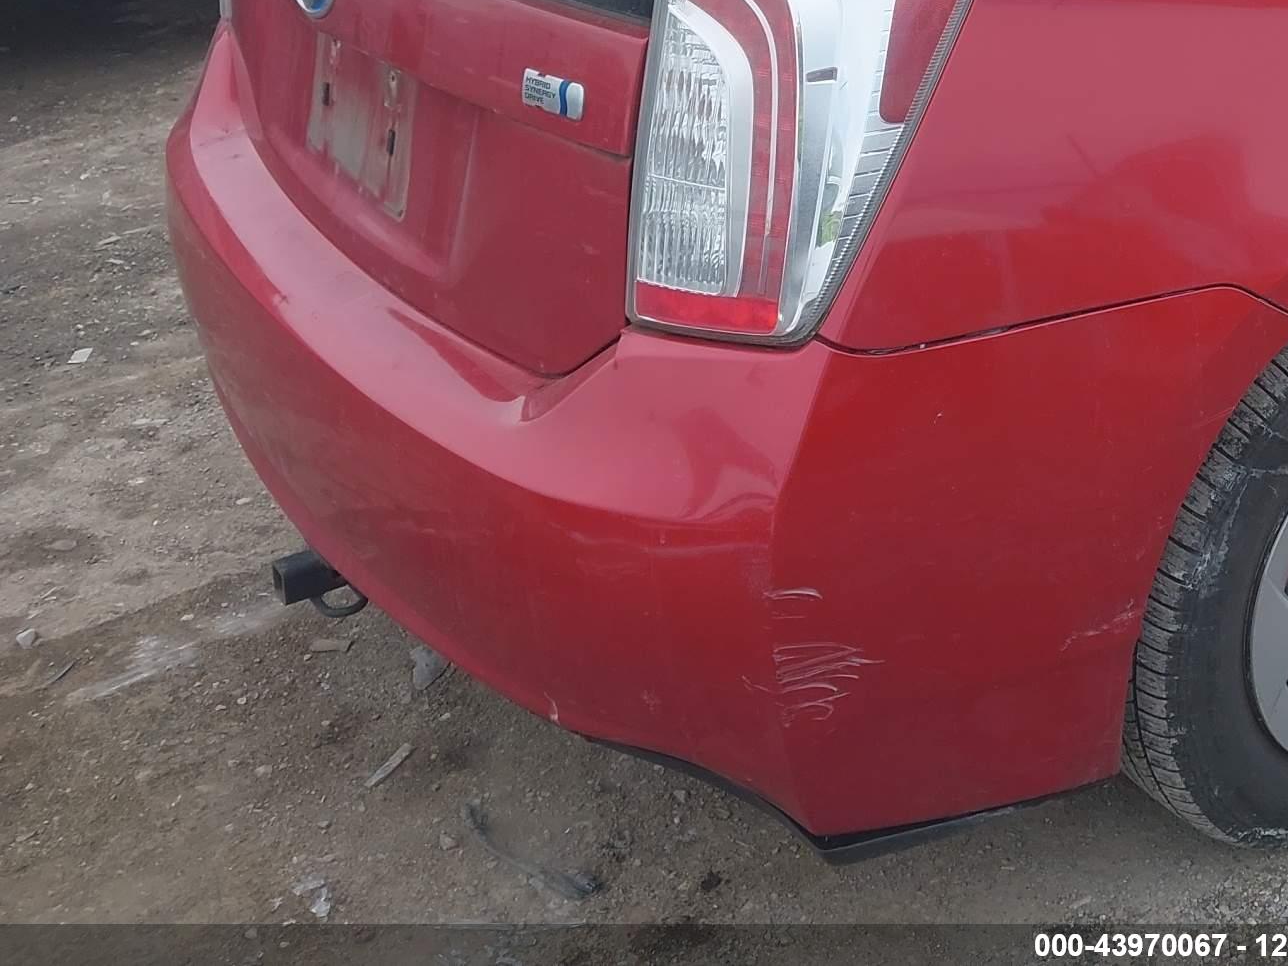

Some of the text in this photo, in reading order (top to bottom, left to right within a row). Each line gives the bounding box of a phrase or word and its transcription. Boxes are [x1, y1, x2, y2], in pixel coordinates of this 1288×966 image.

[526, 76, 551, 90] HYBRID
[524, 92, 545, 105] DRIVE
[525, 85, 556, 99] SYNERGY
